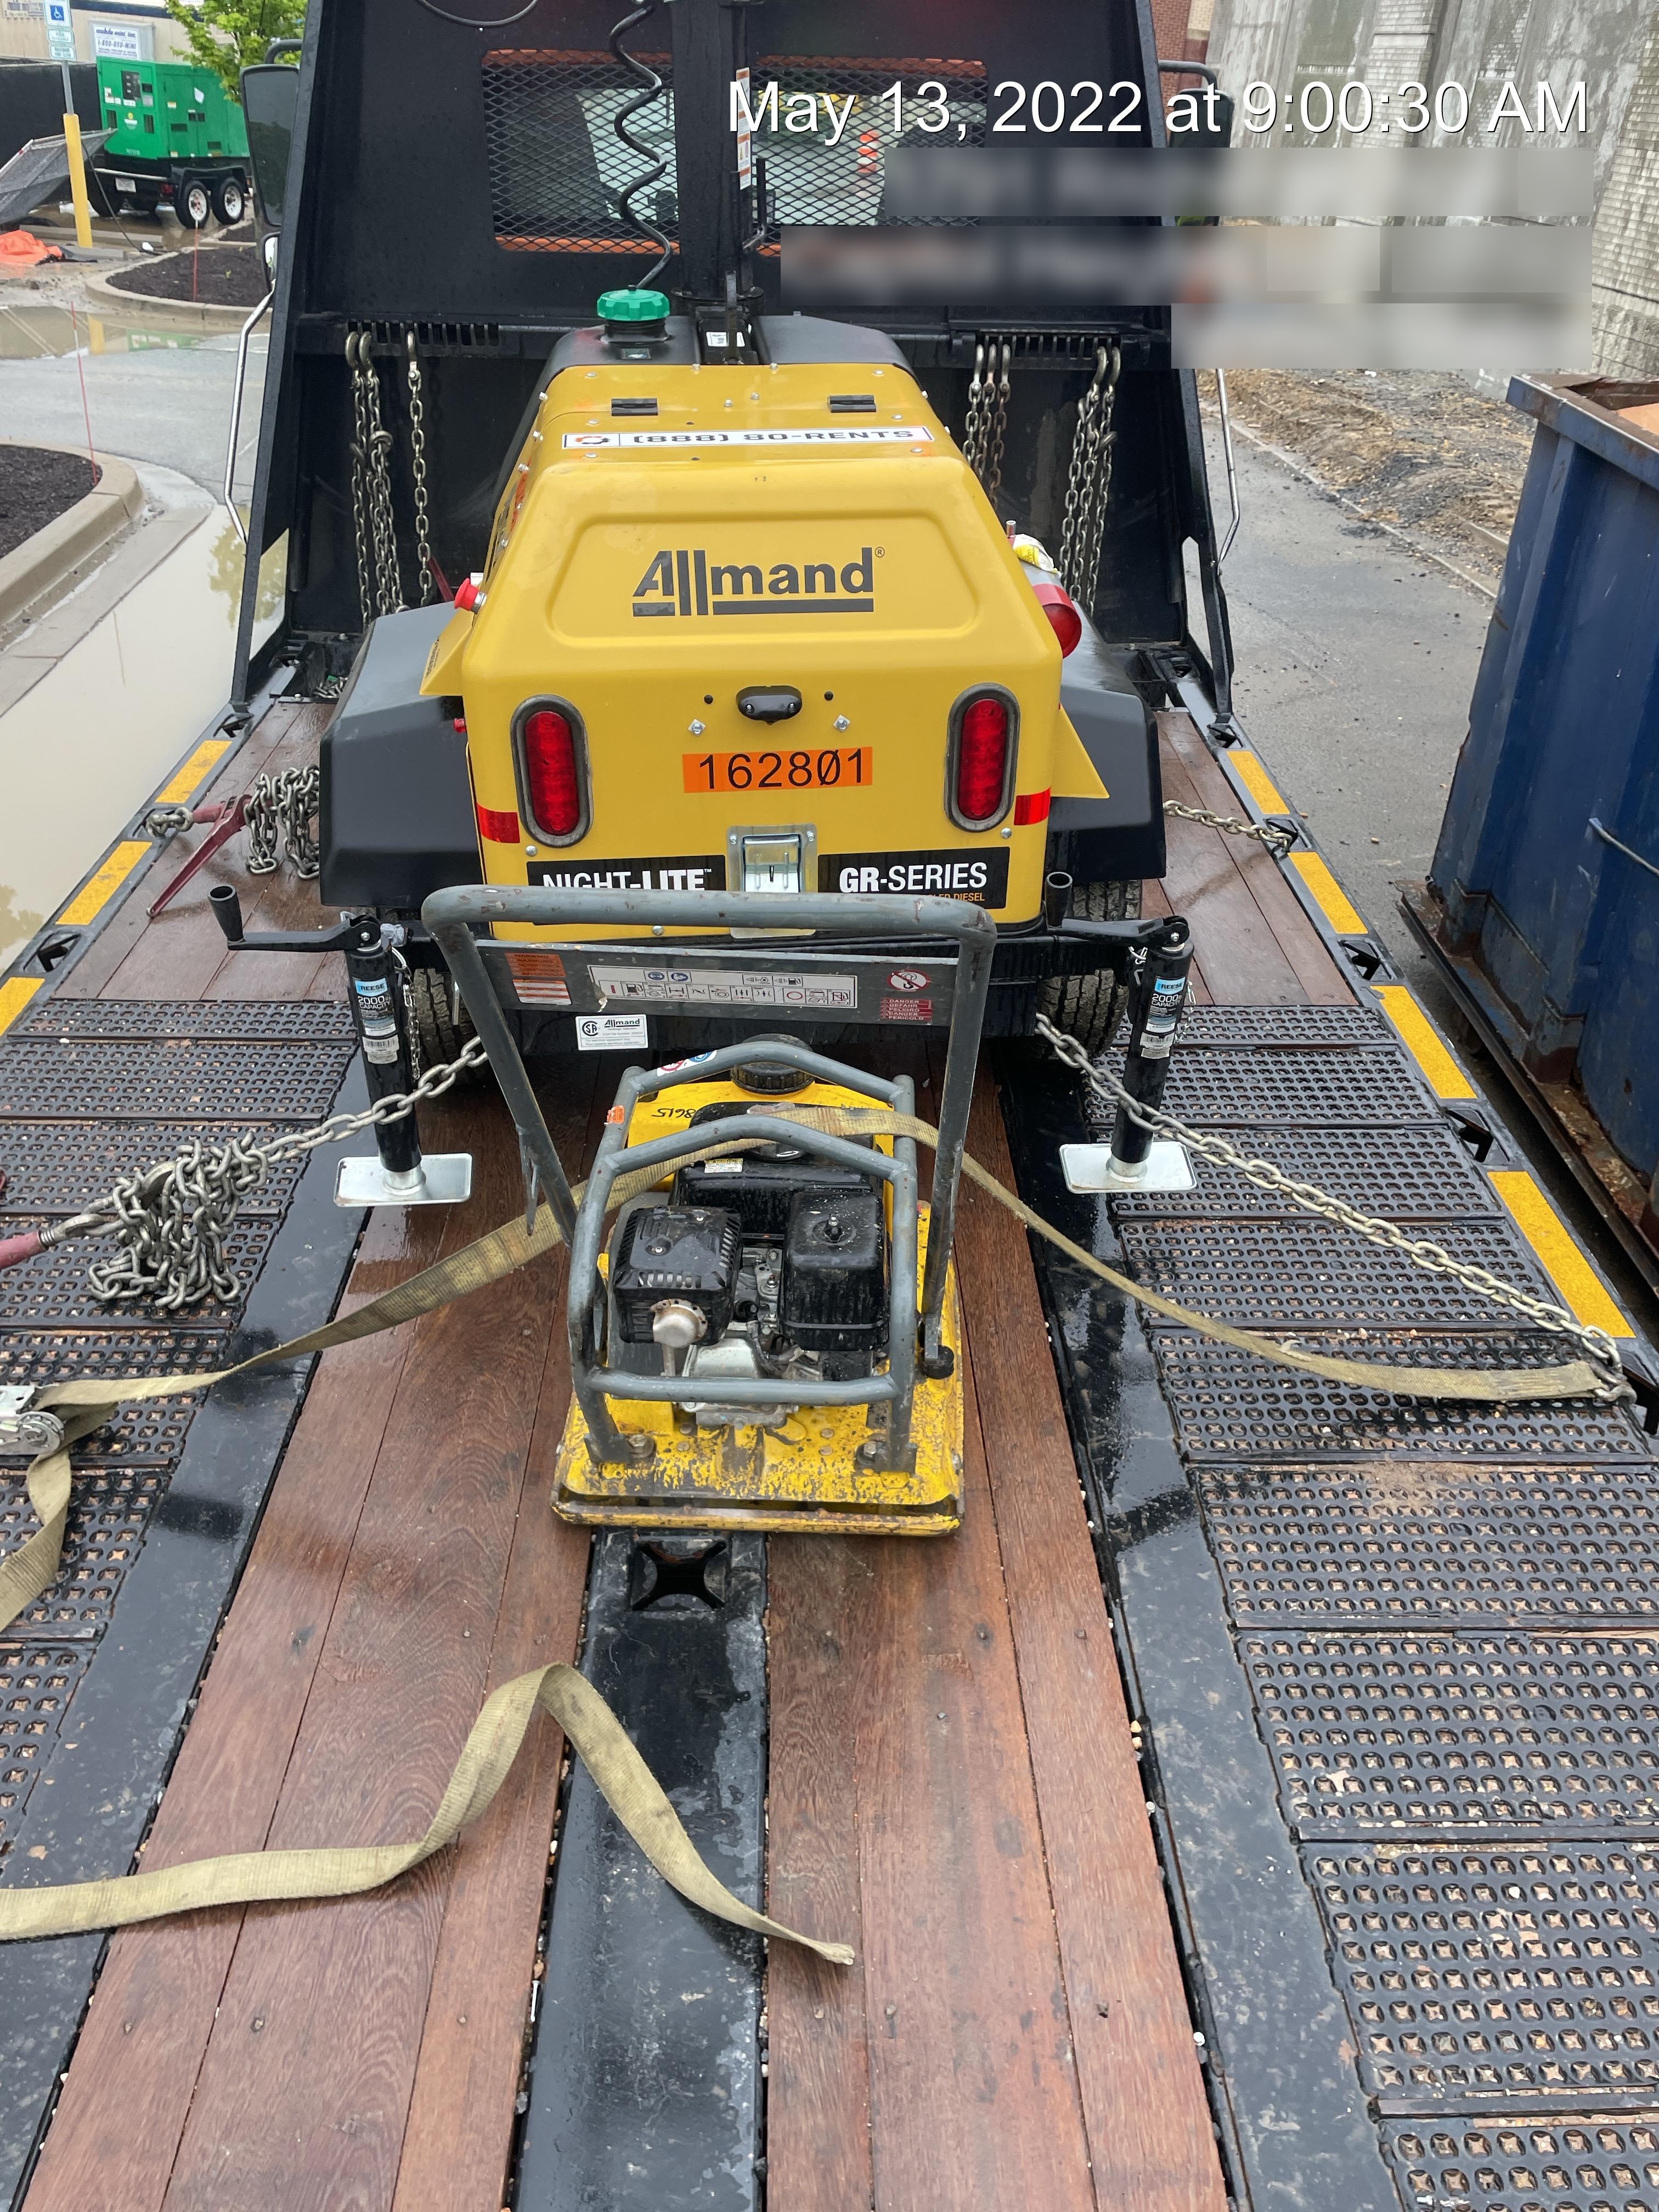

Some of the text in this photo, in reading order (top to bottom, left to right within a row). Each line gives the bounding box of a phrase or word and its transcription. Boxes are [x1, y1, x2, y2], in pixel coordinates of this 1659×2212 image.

[634, 430, 913, 443] (888) 80-RENTS
[632, 547, 874, 617] Allmand
[699, 748, 862, 790] 162801
[839, 862, 987, 893] GR-SERIES
[358, 995, 385, 1005] 2000
[1152, 993, 1179, 1003] 2000
[604, 1019, 640, 1028] Allmand
[651, 1108, 697, 1119] 8615
